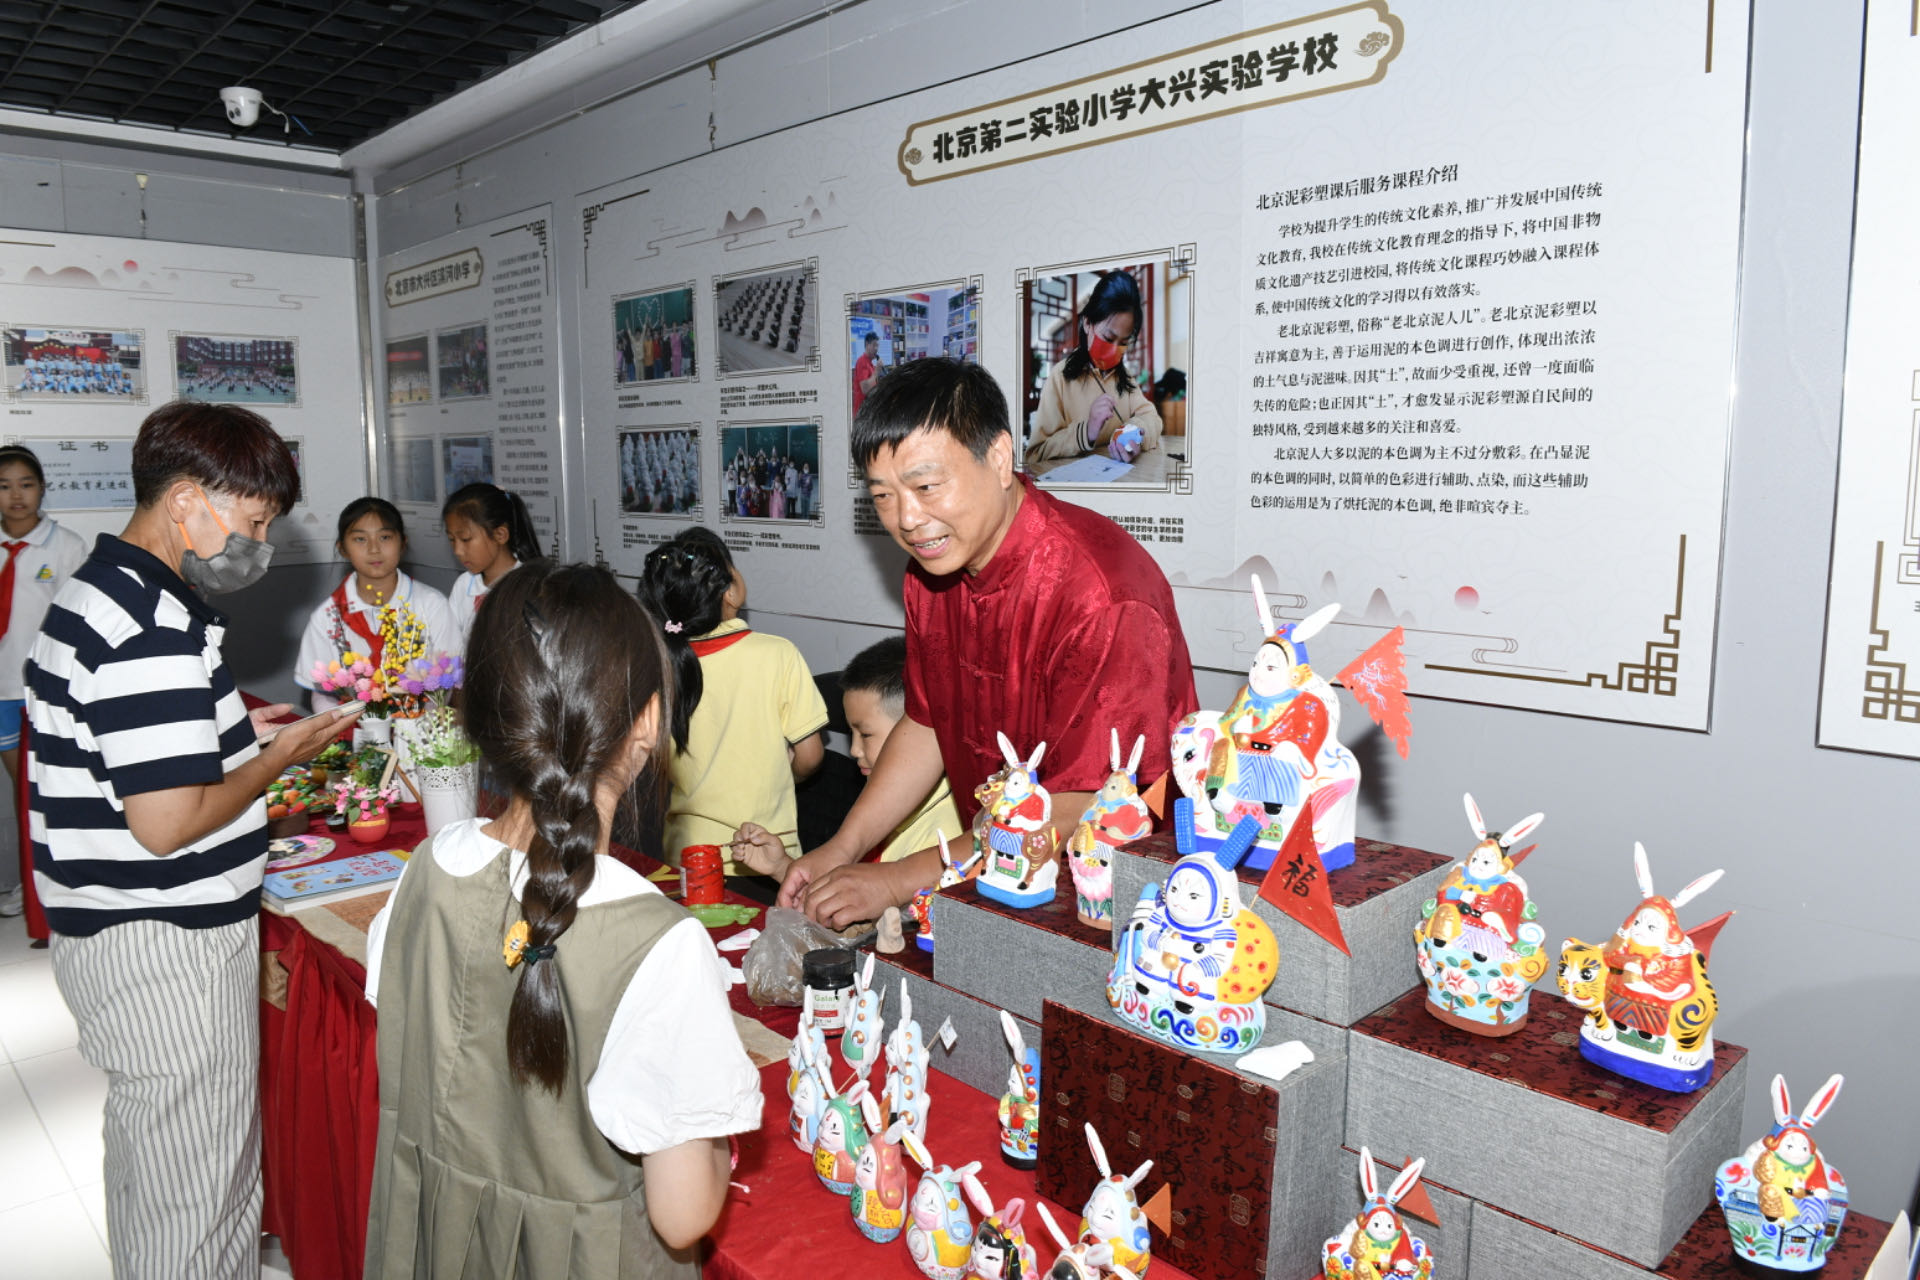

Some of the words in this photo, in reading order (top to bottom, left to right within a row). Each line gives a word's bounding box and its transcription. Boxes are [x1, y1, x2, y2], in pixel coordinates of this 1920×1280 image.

[932, 31, 1339, 164] 北京第二实验小学大兴实验学校
[1255, 163, 1459, 212] 北京泥彩塑课后服务课程介绍
[1285, 854, 1318, 897] 福
